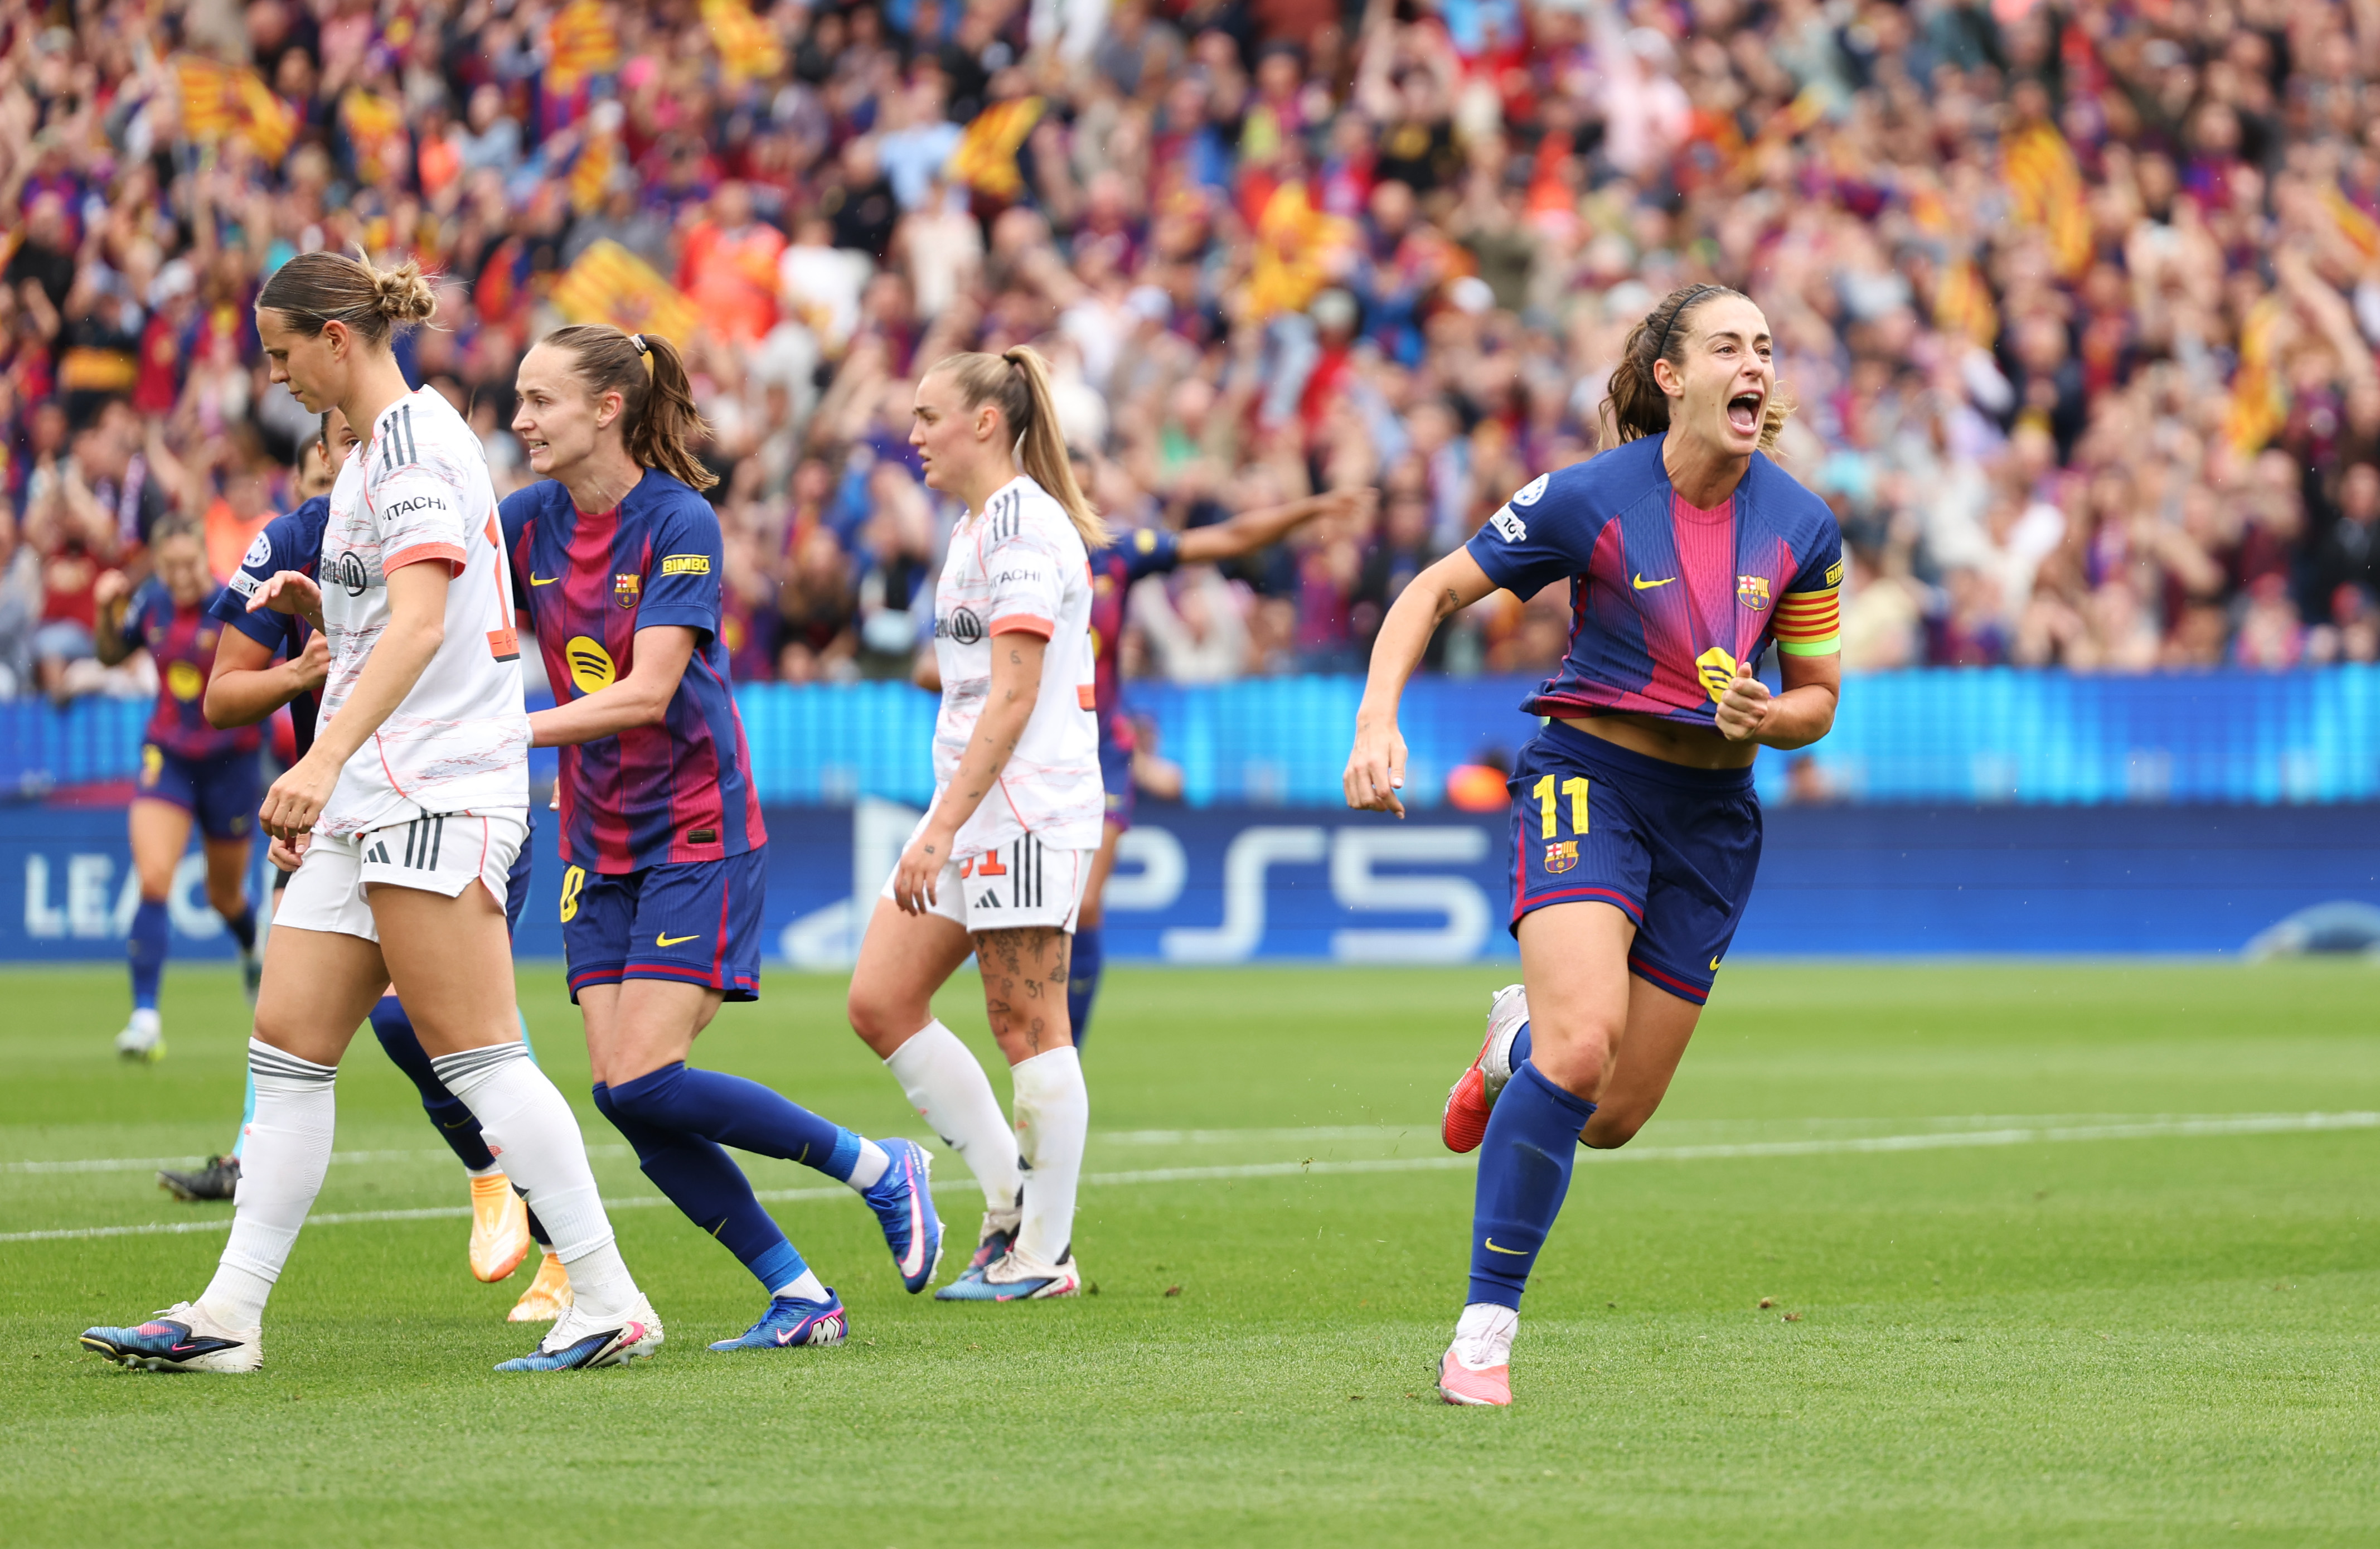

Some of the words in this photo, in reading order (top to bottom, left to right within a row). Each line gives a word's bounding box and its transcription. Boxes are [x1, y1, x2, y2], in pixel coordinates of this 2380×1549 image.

[662, 558, 710, 573] BIMBO
[1533, 773, 1589, 840] 11
[1096, 825, 1494, 964] PS5
